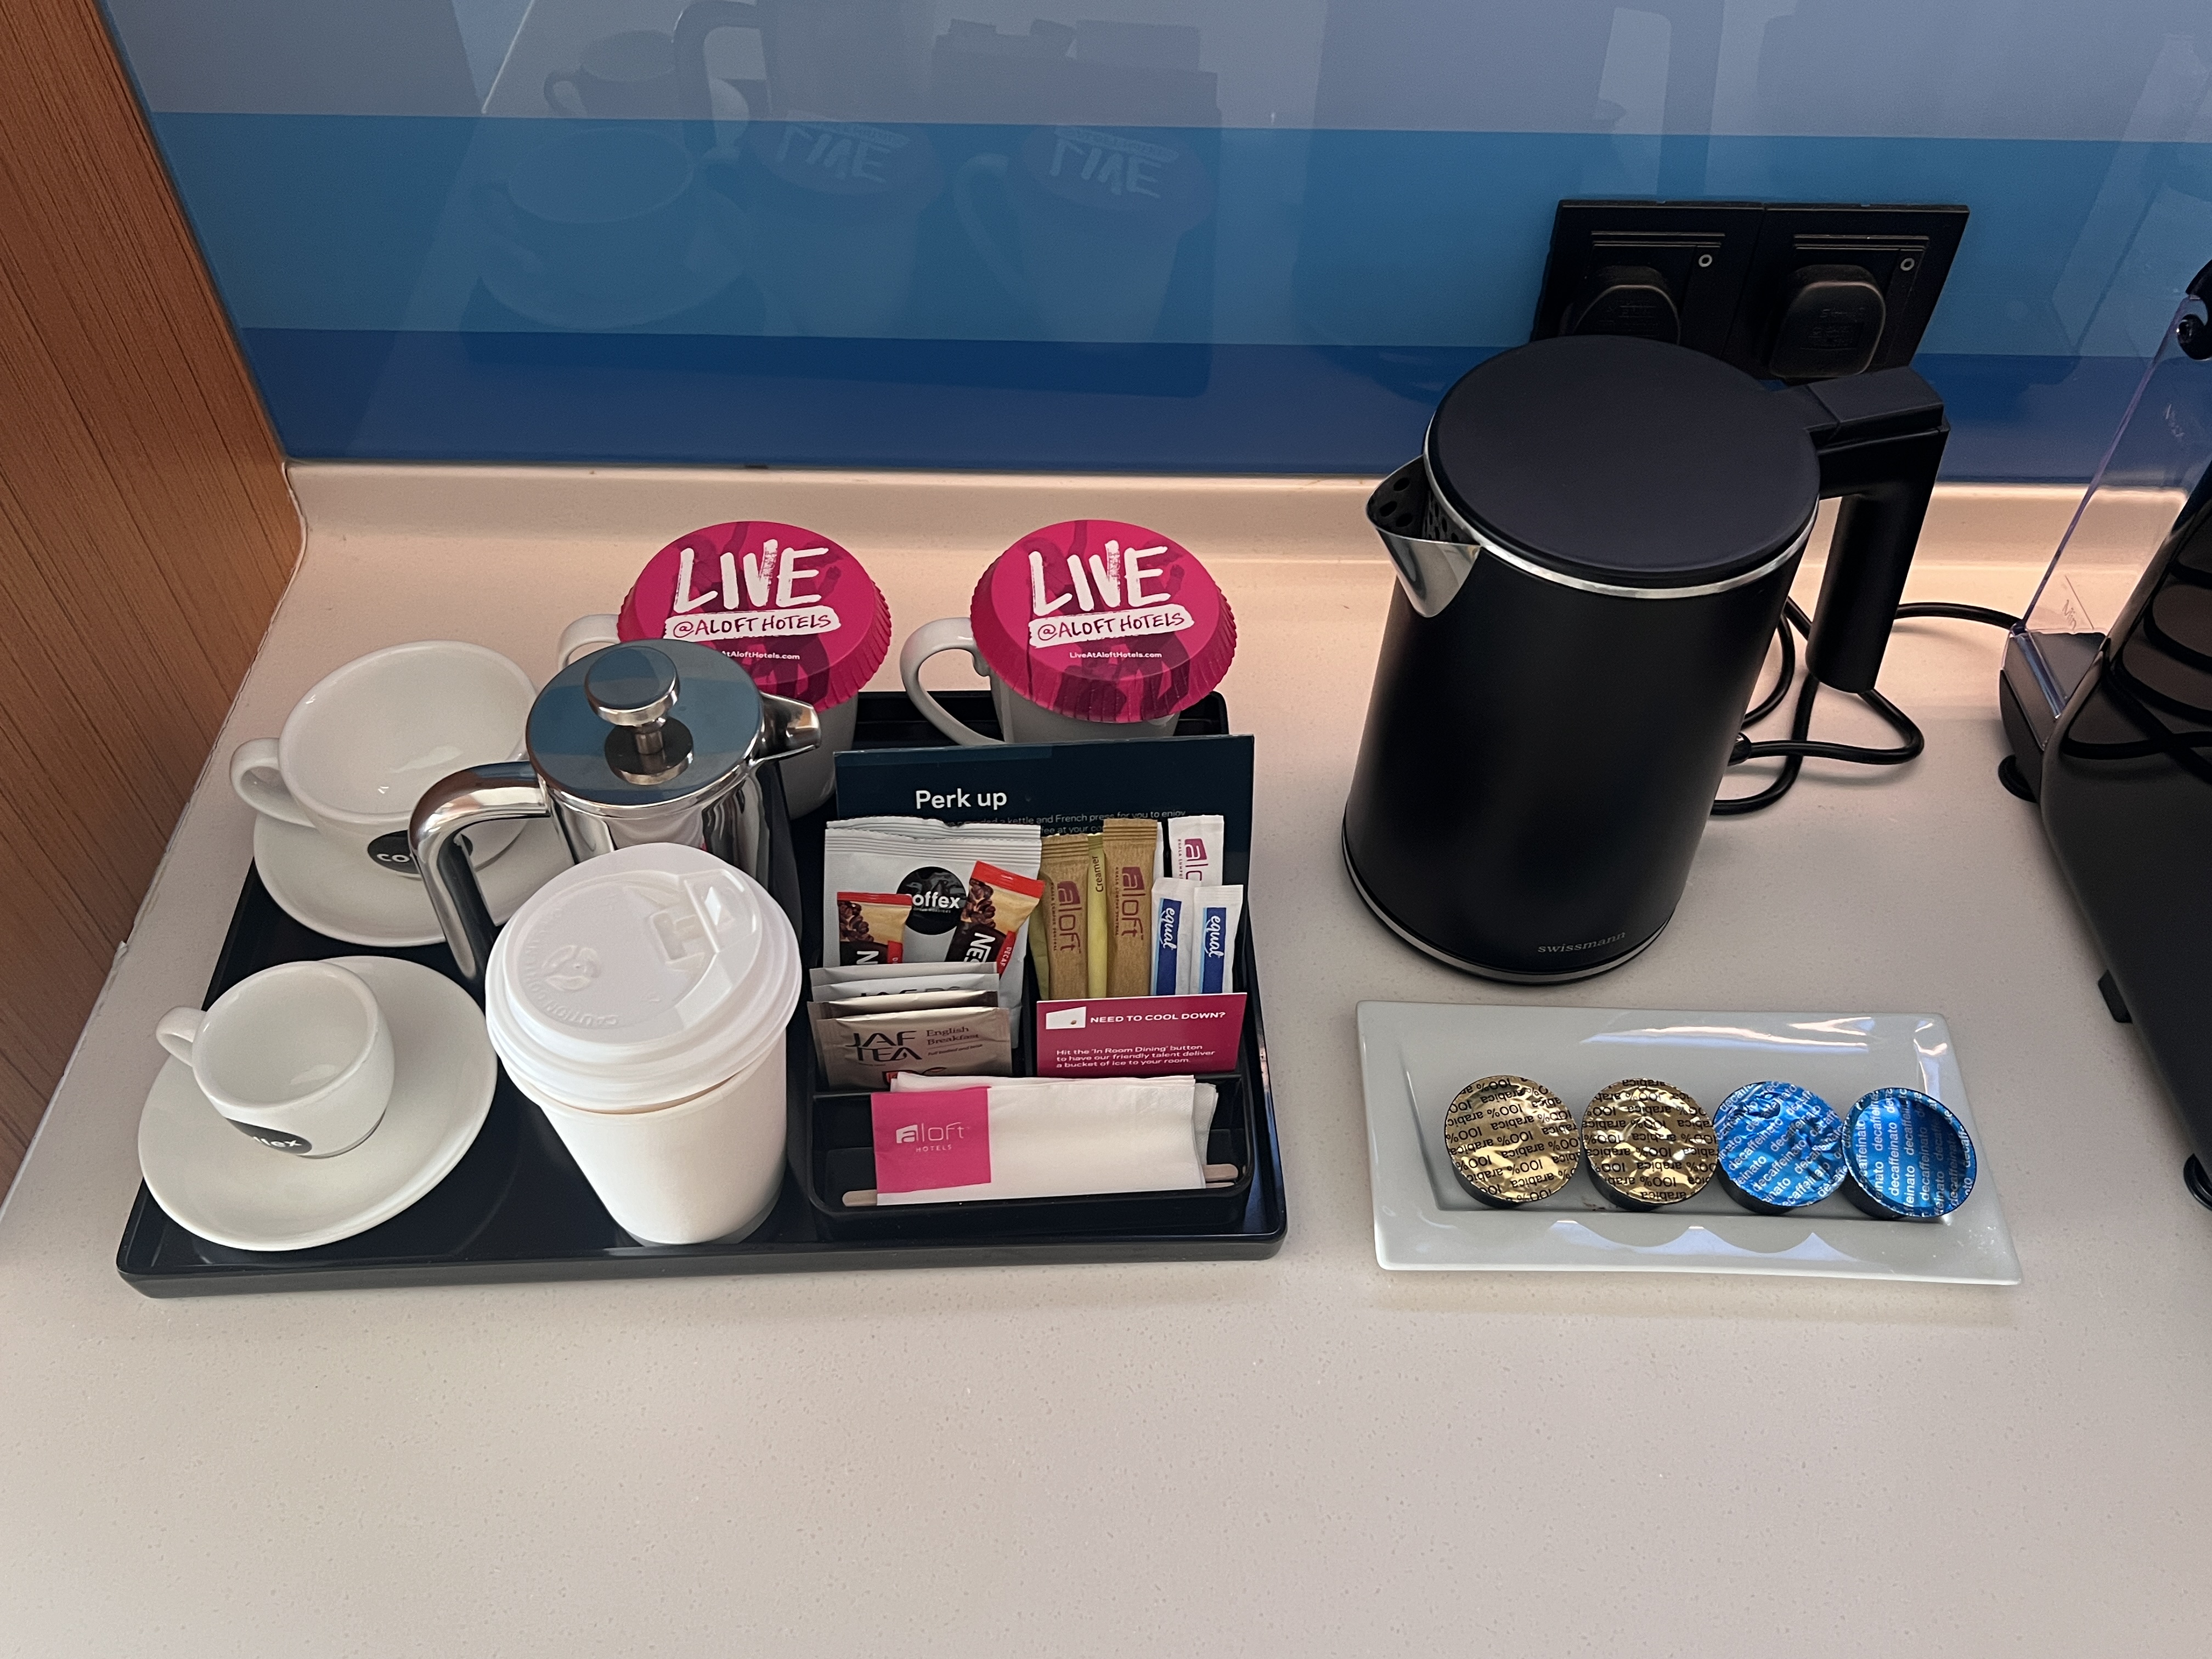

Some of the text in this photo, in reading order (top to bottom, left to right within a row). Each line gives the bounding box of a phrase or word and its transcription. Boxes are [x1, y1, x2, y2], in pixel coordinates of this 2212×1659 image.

[673, 539, 829, 613] LIVE
[1029, 540, 1171, 616] LIVE
[916, 788, 1007, 811] Perk up
[1036, 815, 1053, 823] and
[1056, 814, 1087, 822] French
[1069, 825, 1087, 834] your
[1092, 856, 1103, 892] Creamer
[912, 891, 960, 909] offex
[1121, 867, 1146, 937] aloft
[1057, 881, 1082, 951] aloft
[1159, 908, 1177, 950] equal
[1203, 915, 1224, 958] equal
[1537, 932, 1626, 952] swissmann
[1000, 947, 1012, 967] DECAF
[1181, 1012, 1226, 1020] DOWN?
[845, 1030, 917, 1047] JAF
[927, 1026, 969, 1037] English
[927, 1034, 979, 1046] Breakfast
[856, 1047, 922, 1062] TEA
[1487, 1104, 1522, 1118] 100%
[1627, 1106, 1670, 1115] arabica
[1445, 1111, 1483, 1127] arabic
[1491, 1115, 1534, 1131] arabica
[1582, 1120, 1626, 1130] arabica
[896, 1122, 964, 1143] aloft
[1446, 1126, 1482, 1143] 100%
[1497, 1131, 1533, 1146] 100%
[1449, 1139, 1493, 1155] arabica
[1500, 1143, 1544, 1159] arabica
[1729, 1118, 1783, 1171] decaffeinato
[1637, 1162, 1682, 1171] arabica
[1753, 1140, 1807, 1192] decaffeinato
[1887, 1121, 1900, 1196] decaffeinato
[1918, 1127, 1930, 1200] decaffeinato
[1507, 1159, 1543, 1175] 100%
[1510, 1173, 1554, 1188] arabica
[1640, 1176, 1676, 1187] 100%
[1640, 1192, 1686, 1201] arabica
